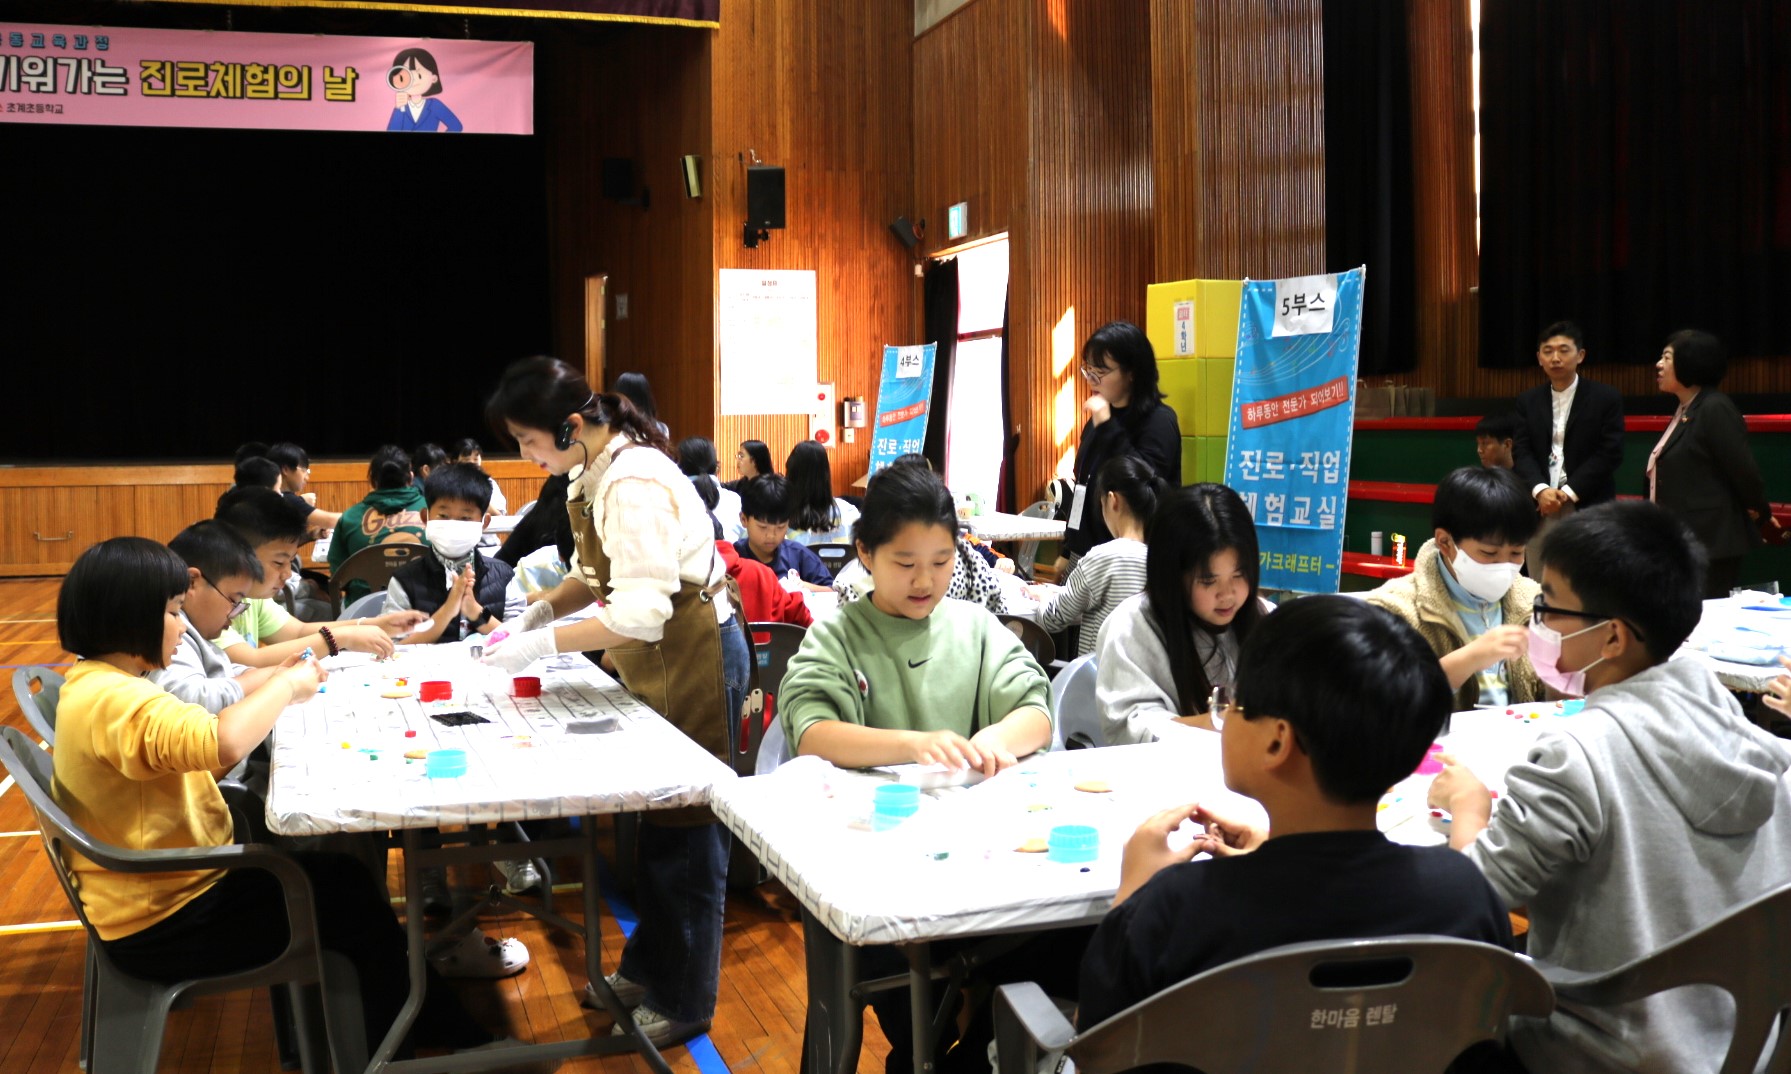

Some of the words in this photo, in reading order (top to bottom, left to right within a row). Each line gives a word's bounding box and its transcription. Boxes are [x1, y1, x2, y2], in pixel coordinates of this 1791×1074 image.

[0, 31, 110, 51] 동교육과정
[139, 59, 312, 101] 진로체험의
[322, 65, 359, 102] 날
[6, 102, 64, 115] 초계초등학교
[1281, 292, 1326, 316] 5부스
[900, 354, 920, 367] 4부스
[1247, 401, 1279, 422] 하루동안
[1282, 394, 1307, 414] 전문가
[1310, 1007, 1361, 1029] 한마음
[1365, 1003, 1398, 1026] 렌탈
